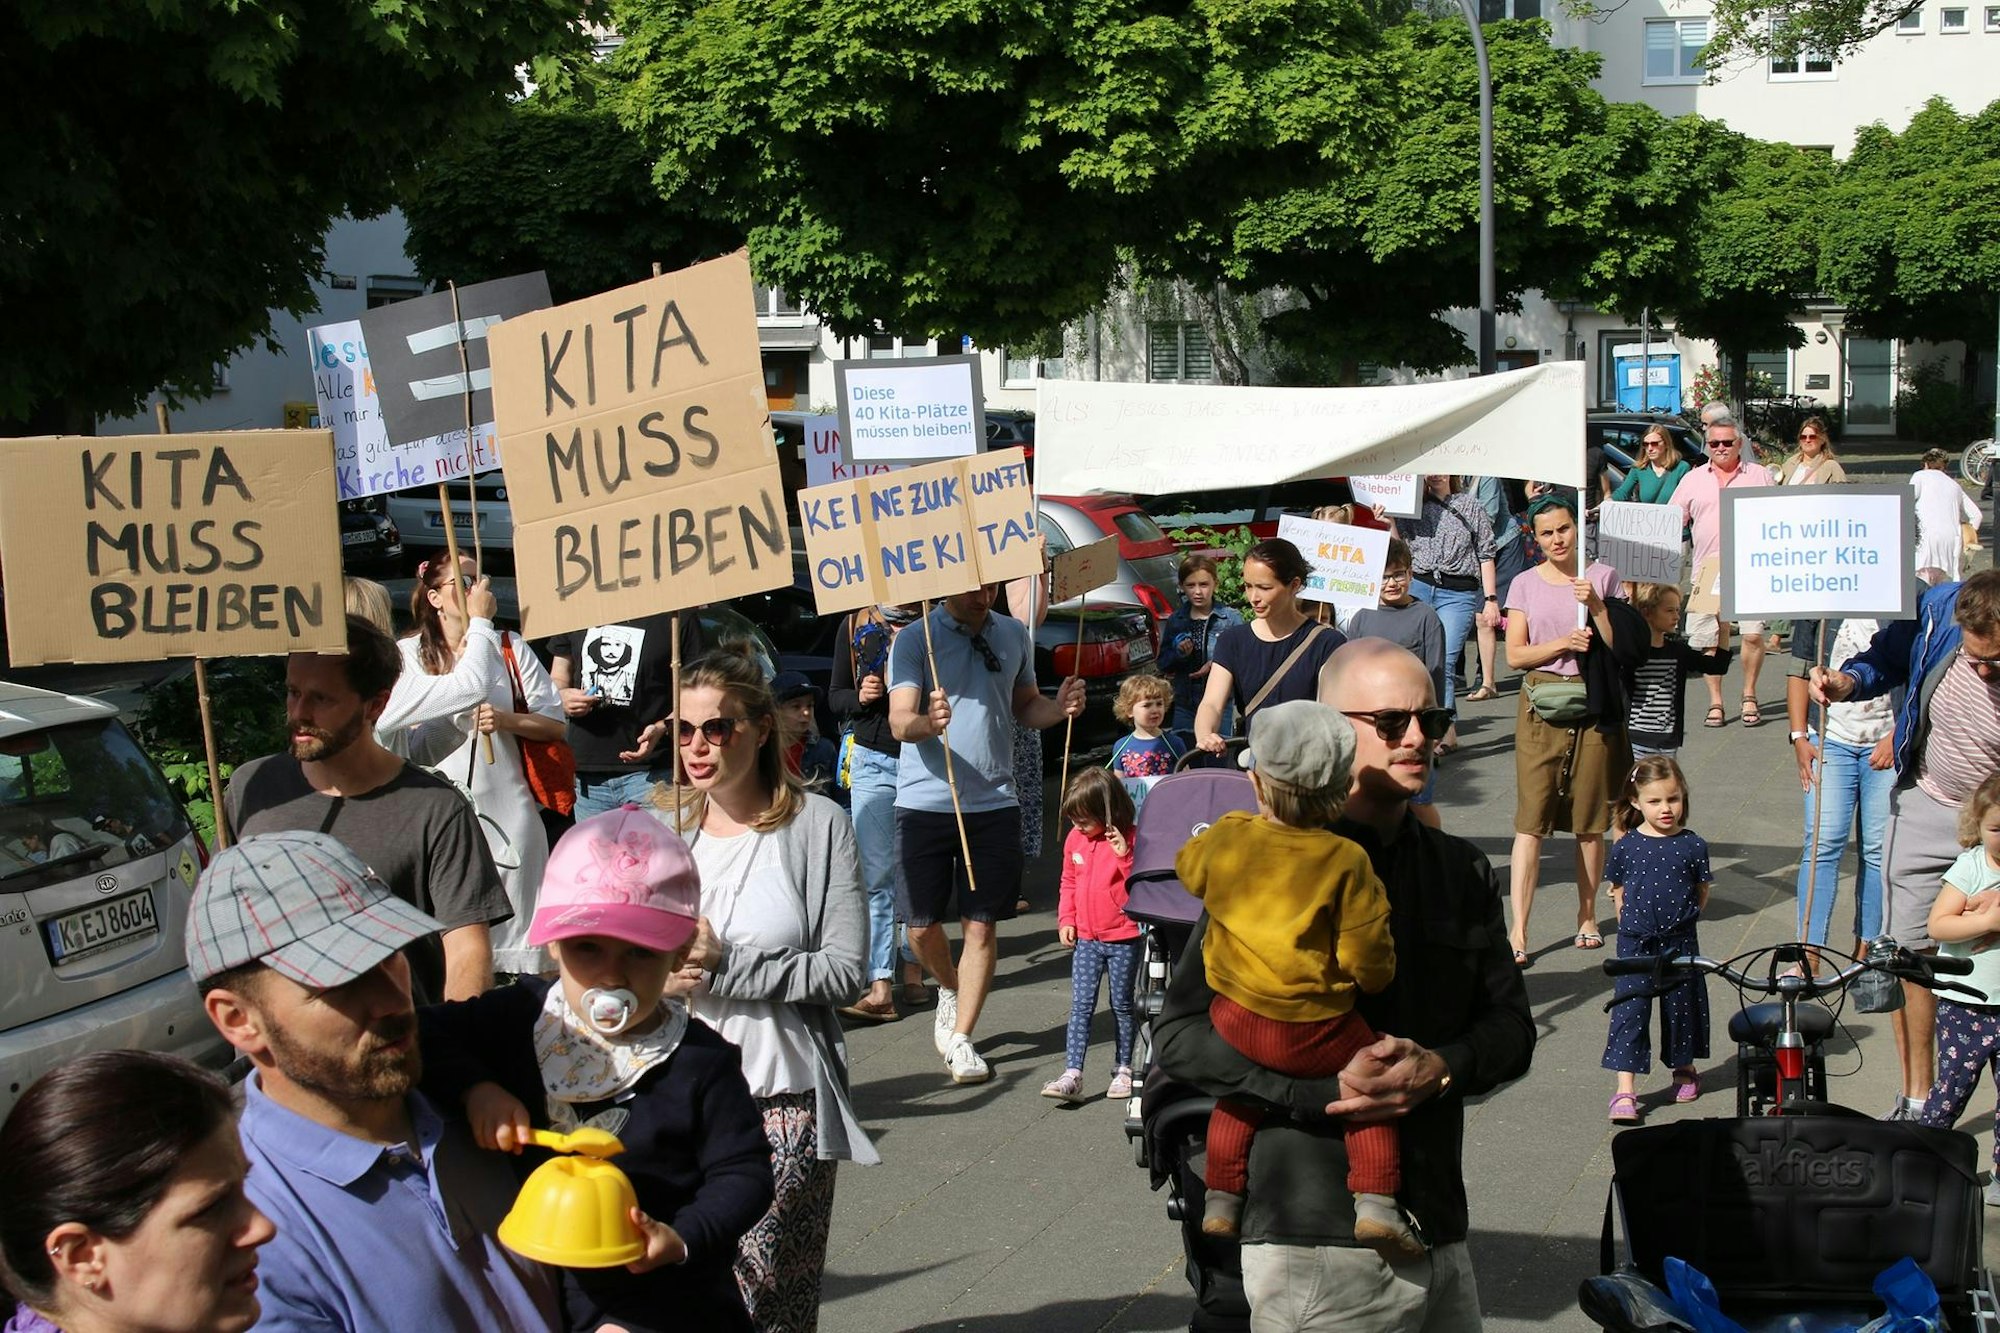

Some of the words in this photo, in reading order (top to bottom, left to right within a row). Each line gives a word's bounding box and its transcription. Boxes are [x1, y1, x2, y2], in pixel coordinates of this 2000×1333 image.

[541, 299, 710, 416] KITA
[318, 373, 353, 400] Alle
[853, 386, 895, 400] Diese
[344, 409, 369, 424] mir
[855, 406, 875, 420] 40
[879, 403, 968, 420] Kita-Plätze
[856, 425, 909, 438] müssen
[913, 422, 972, 437] bleiben!
[336, 446, 358, 460] as
[546, 405, 719, 503] MUSS
[82, 446, 256, 511] KITA
[337, 456, 426, 499] Kirche
[1369, 483, 1401, 495] leben!
[1762, 521, 1792, 540] Ich
[1800, 519, 1839, 538] will
[1848, 519, 1867, 538] in
[86, 520, 265, 577] MUSS
[554, 488, 786, 600] BLEIBEN
[1317, 543, 1365, 564] KITA
[1751, 547, 1828, 567] meiner
[1836, 546, 1879, 564] Kita
[1771, 573, 1858, 593] bleiben!
[90, 582, 323, 639] BLEIBEN
[1743, 1148, 1865, 1187] akfiets
